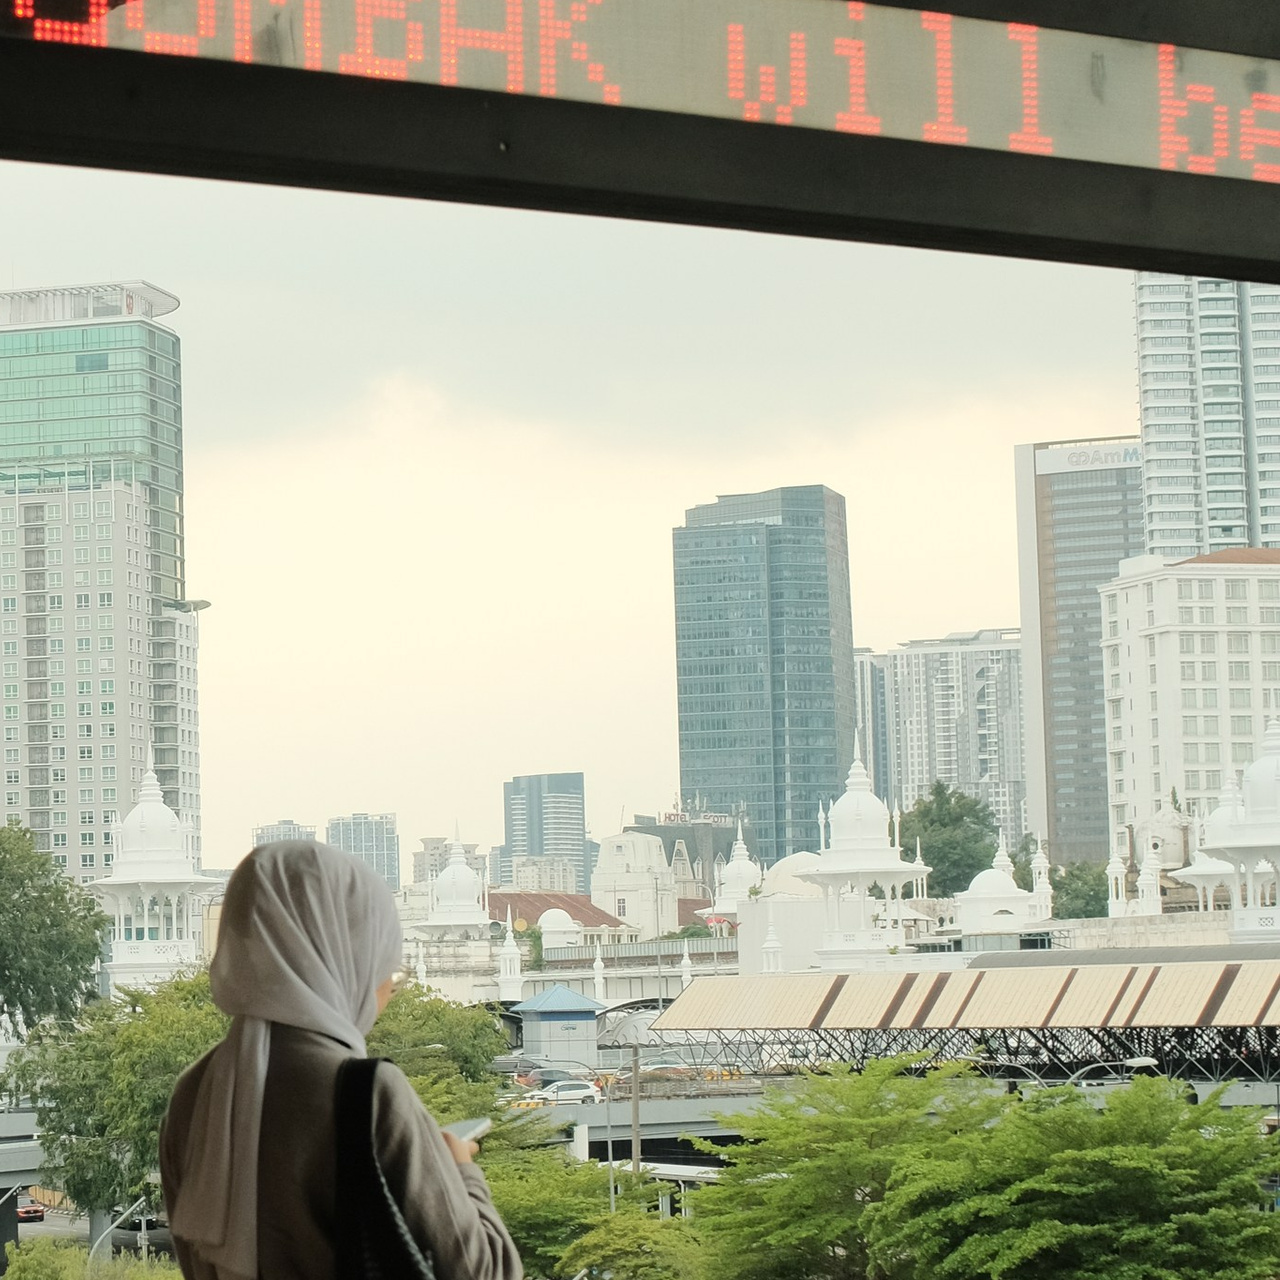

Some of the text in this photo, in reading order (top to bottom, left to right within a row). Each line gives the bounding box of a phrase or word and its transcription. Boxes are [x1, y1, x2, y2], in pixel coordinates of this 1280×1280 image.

[727, 0, 1053, 154] will
[1090, 447, 1141, 465] AmM
[664, 812, 688, 823] HOTEL
